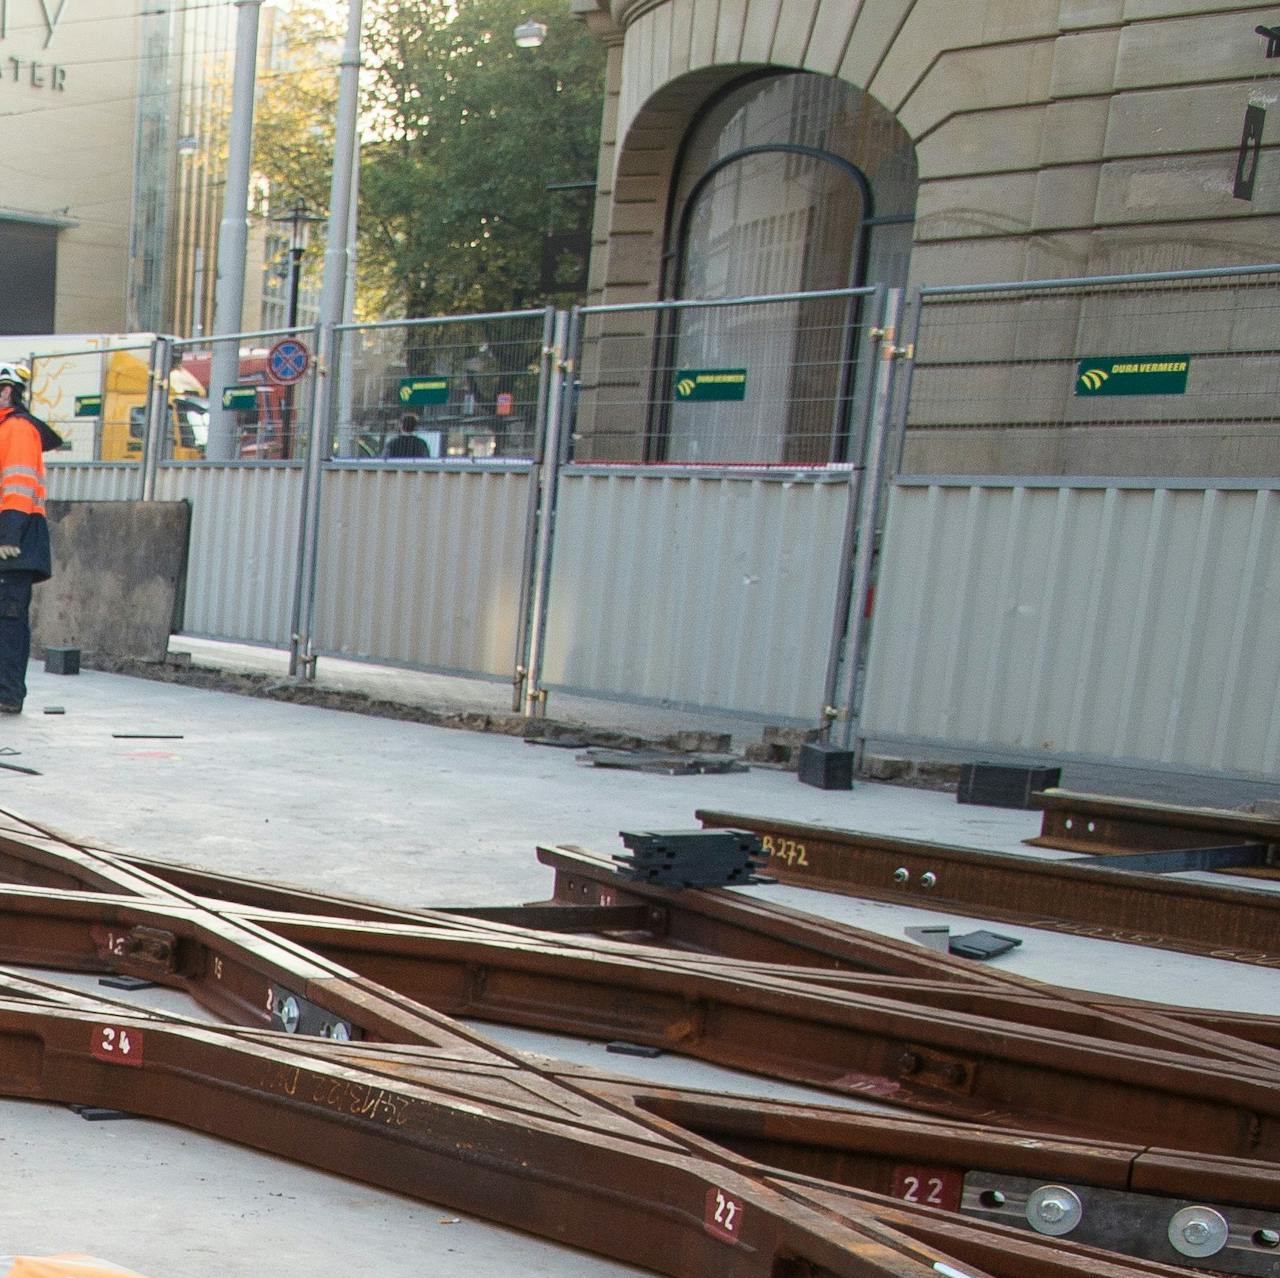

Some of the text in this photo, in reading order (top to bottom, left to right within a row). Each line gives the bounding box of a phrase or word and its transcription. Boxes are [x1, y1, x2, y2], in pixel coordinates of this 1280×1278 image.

[1111, 362, 1187, 374] DURA VERMEER
[101, 1027, 131, 1055] 24
[903, 1176, 943, 1204] 22
[714, 1189, 734, 1231] 22
